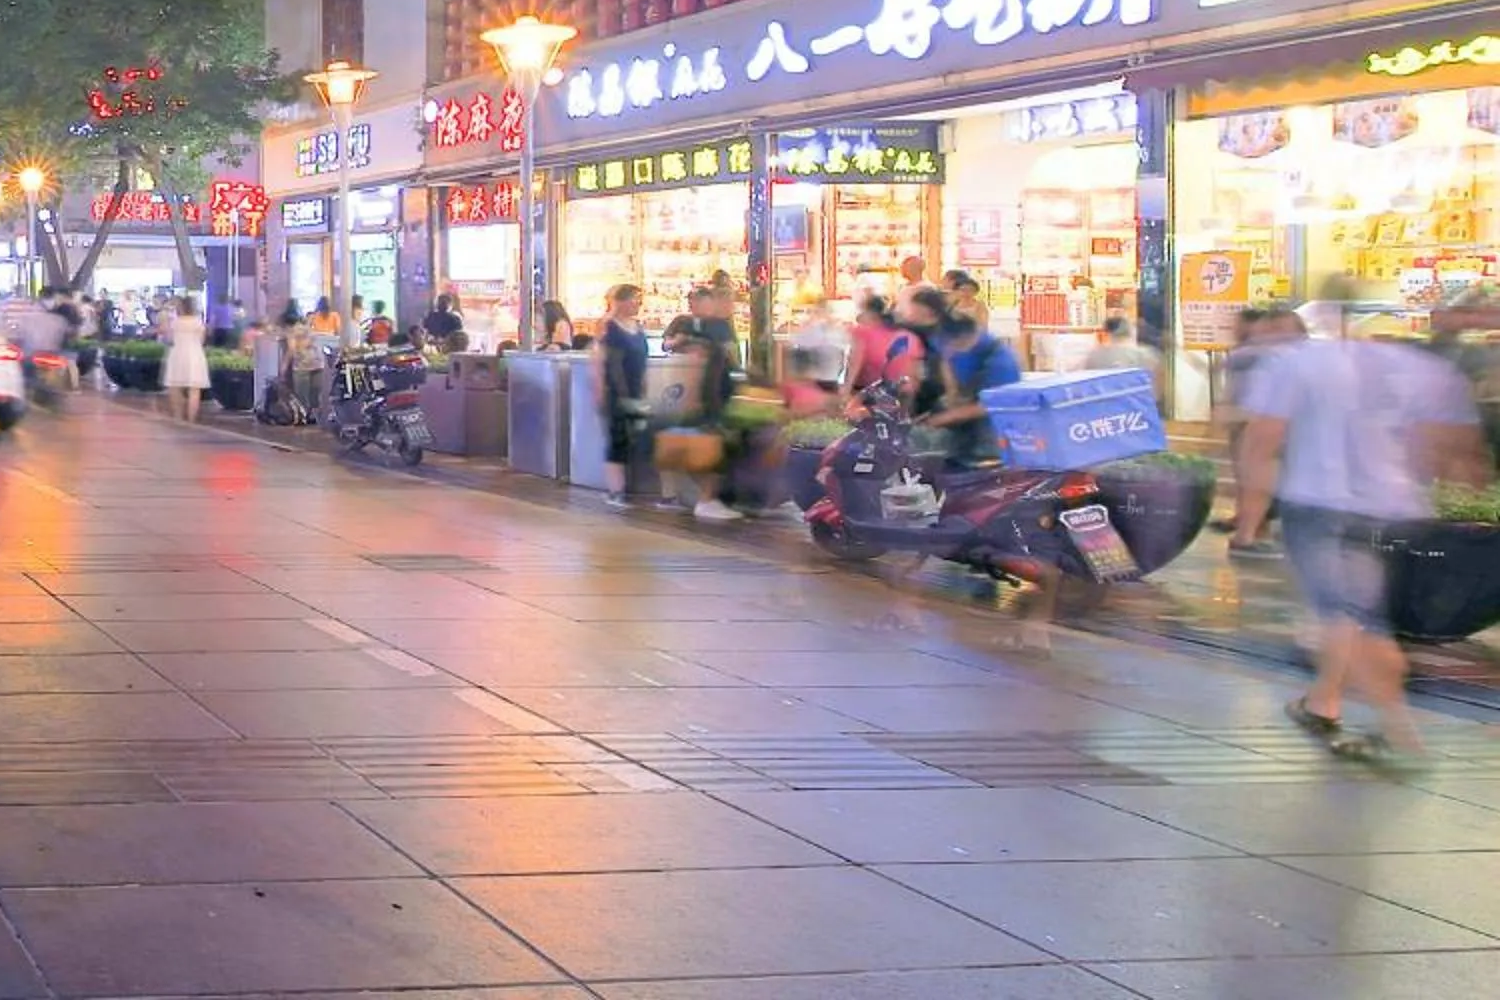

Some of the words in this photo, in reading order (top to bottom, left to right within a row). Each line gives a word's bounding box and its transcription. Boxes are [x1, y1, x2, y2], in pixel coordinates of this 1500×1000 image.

[437, 89, 524, 147] 陈麻花
[447, 180, 515, 224] 重庆特
